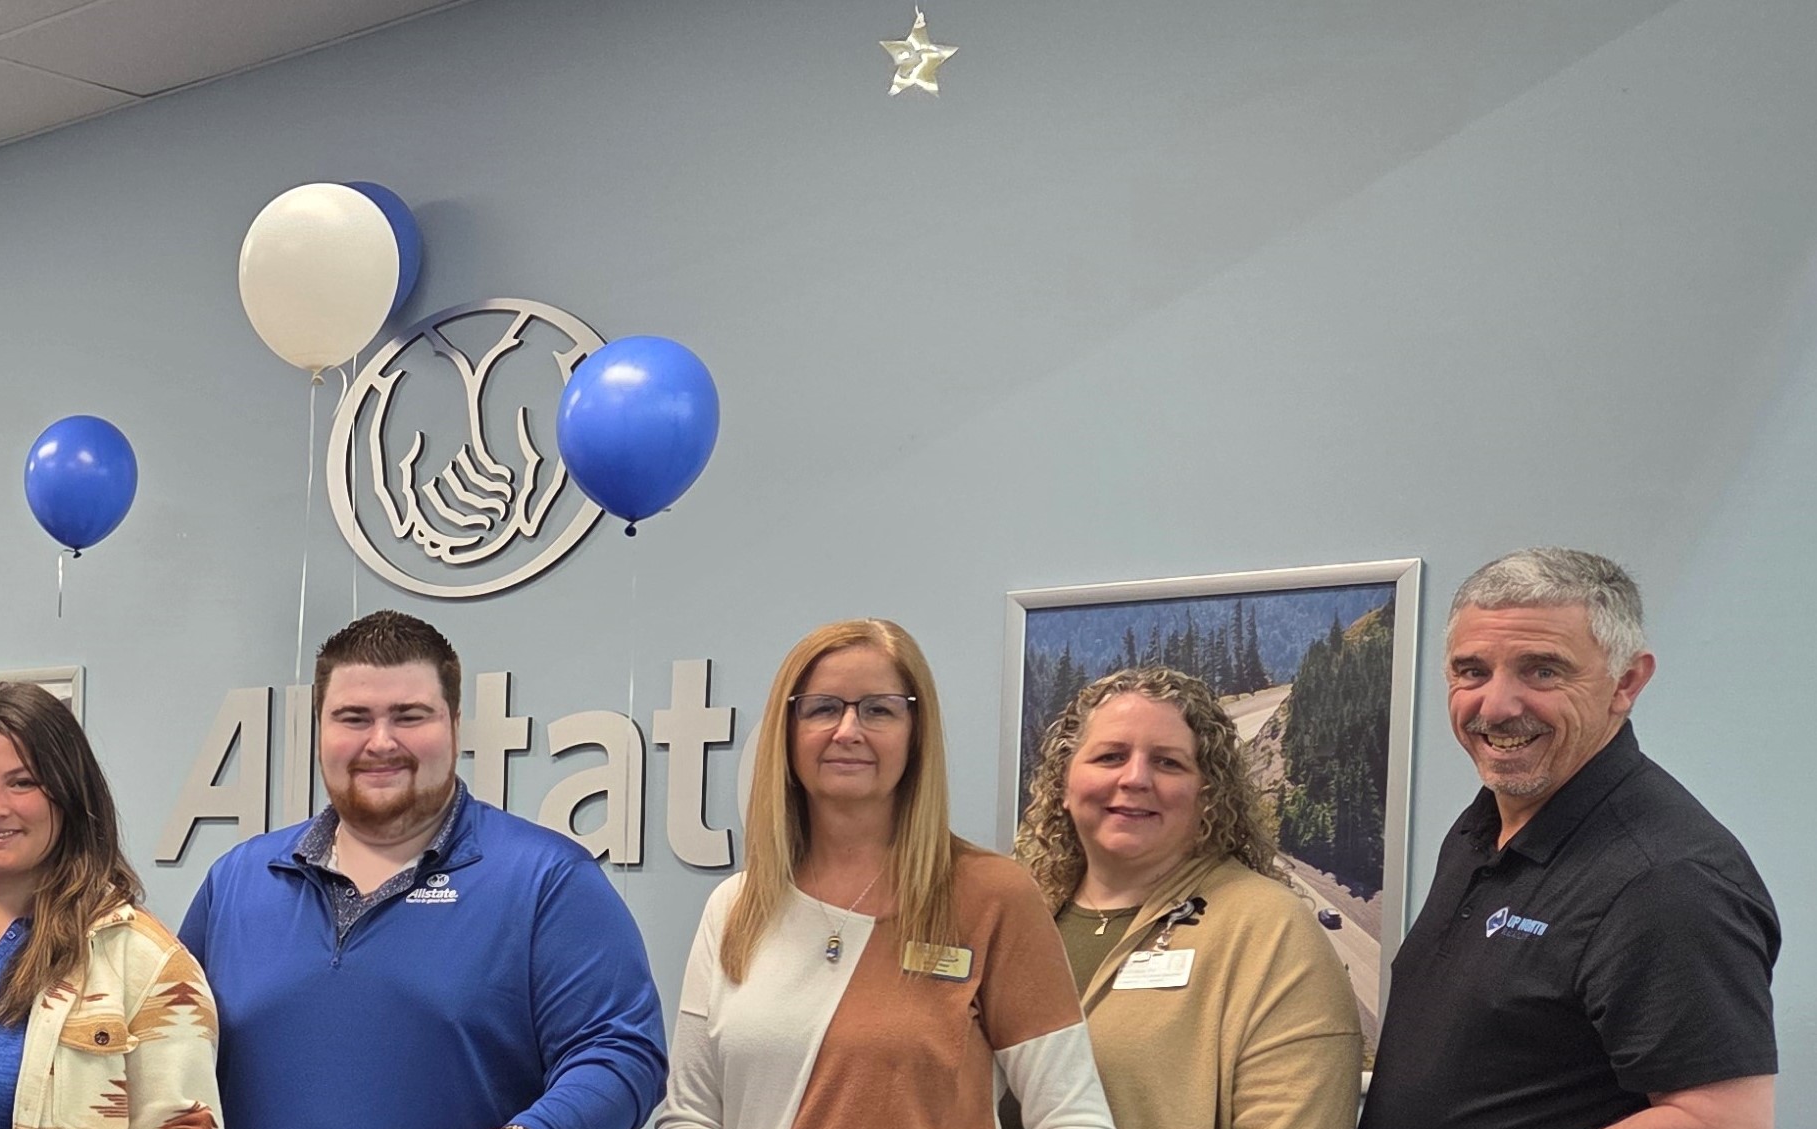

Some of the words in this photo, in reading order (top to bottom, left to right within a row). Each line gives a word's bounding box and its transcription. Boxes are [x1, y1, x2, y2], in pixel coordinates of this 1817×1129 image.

[154, 658, 763, 868] Altat
[406, 888, 456, 899] Allstate
[1506, 915, 1522, 929] UP
[1517, 918, 1549, 936] NORTH
